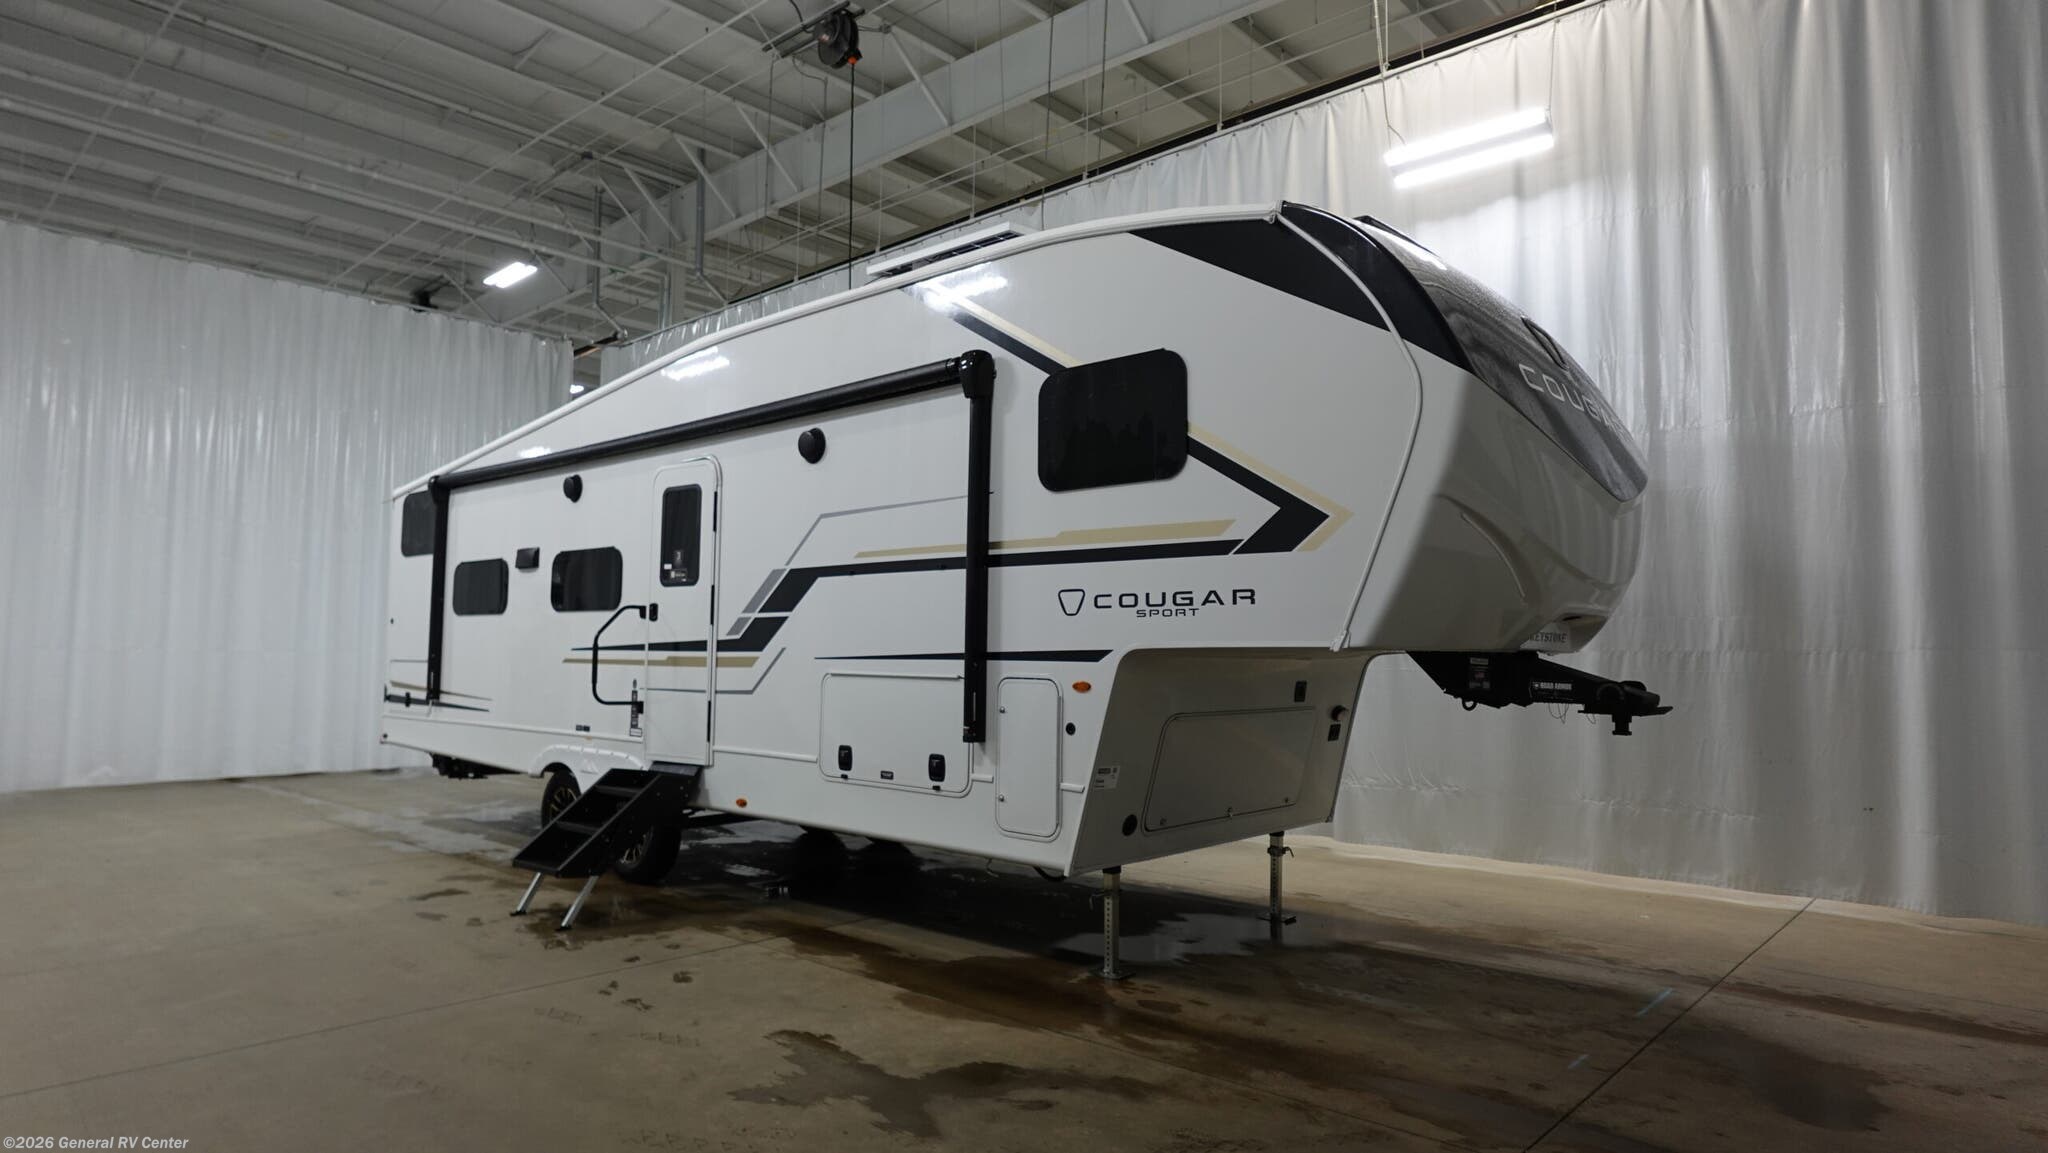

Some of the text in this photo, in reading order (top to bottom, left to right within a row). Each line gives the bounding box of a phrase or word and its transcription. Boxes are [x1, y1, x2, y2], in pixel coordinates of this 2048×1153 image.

[1518, 363, 1633, 441] COUG
[1093, 588, 1256, 609] COUGAR
[1136, 608, 1200, 618] SPORT
